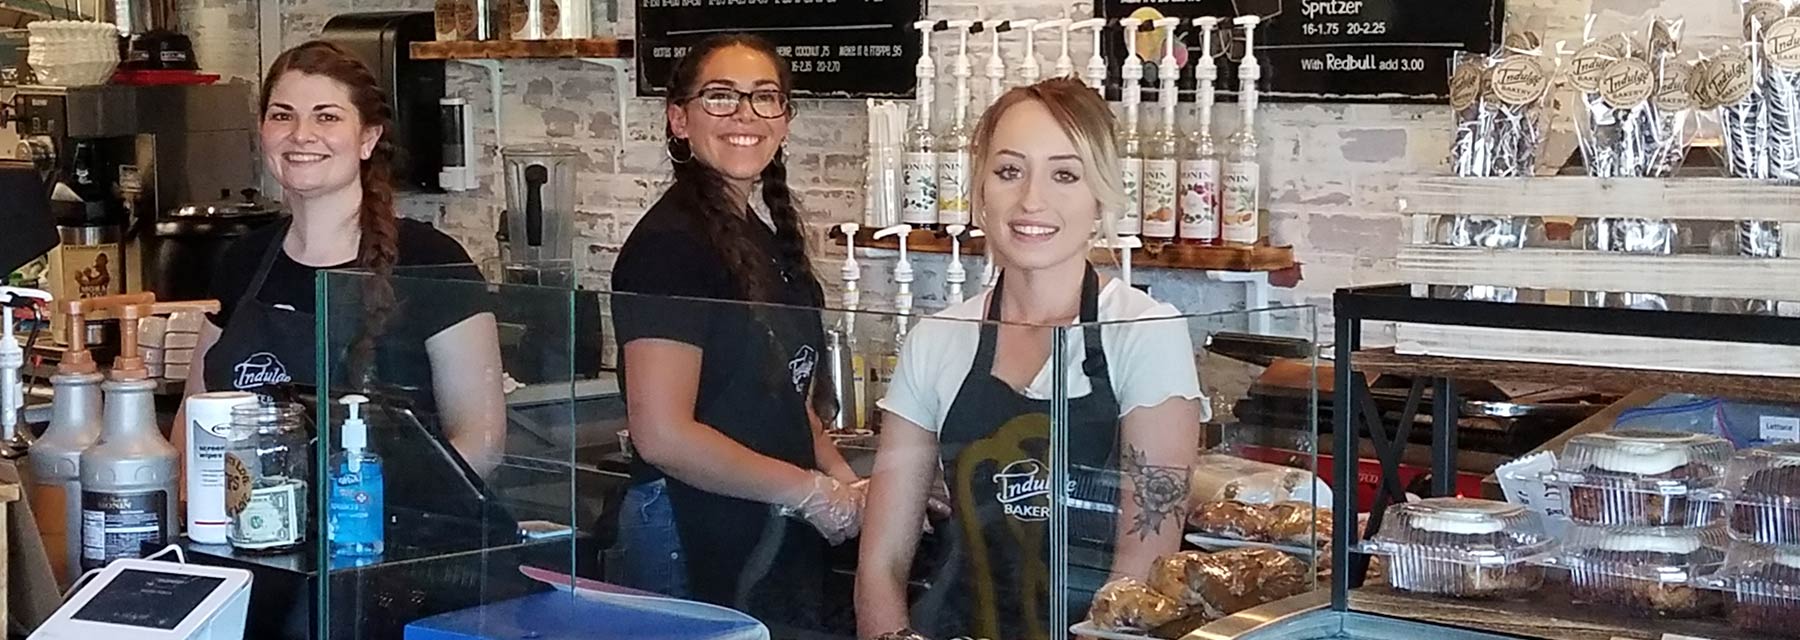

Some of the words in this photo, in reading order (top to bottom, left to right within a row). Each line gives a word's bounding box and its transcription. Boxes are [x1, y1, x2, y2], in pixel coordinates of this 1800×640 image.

[1301, 0, 1363, 19] Spritzer
[1302, 23, 1339, 35] 16-1.75
[1346, 22, 1386, 34] 20-2.25
[1766, 27, 1800, 55] Indu
[1301, 59, 1323, 70] With
[1325, 53, 1376, 71] Redbull
[1379, 59, 1399, 71] add
[1400, 58, 1425, 71] 3.00
[1571, 57, 1611, 76] Indul
[1496, 65, 1543, 87] Indulge
[1603, 66, 1650, 94] Indulge
[1708, 62, 1748, 97] Indulge
[992, 463, 1077, 503] Indule
[1003, 504, 1050, 518] BAKER
